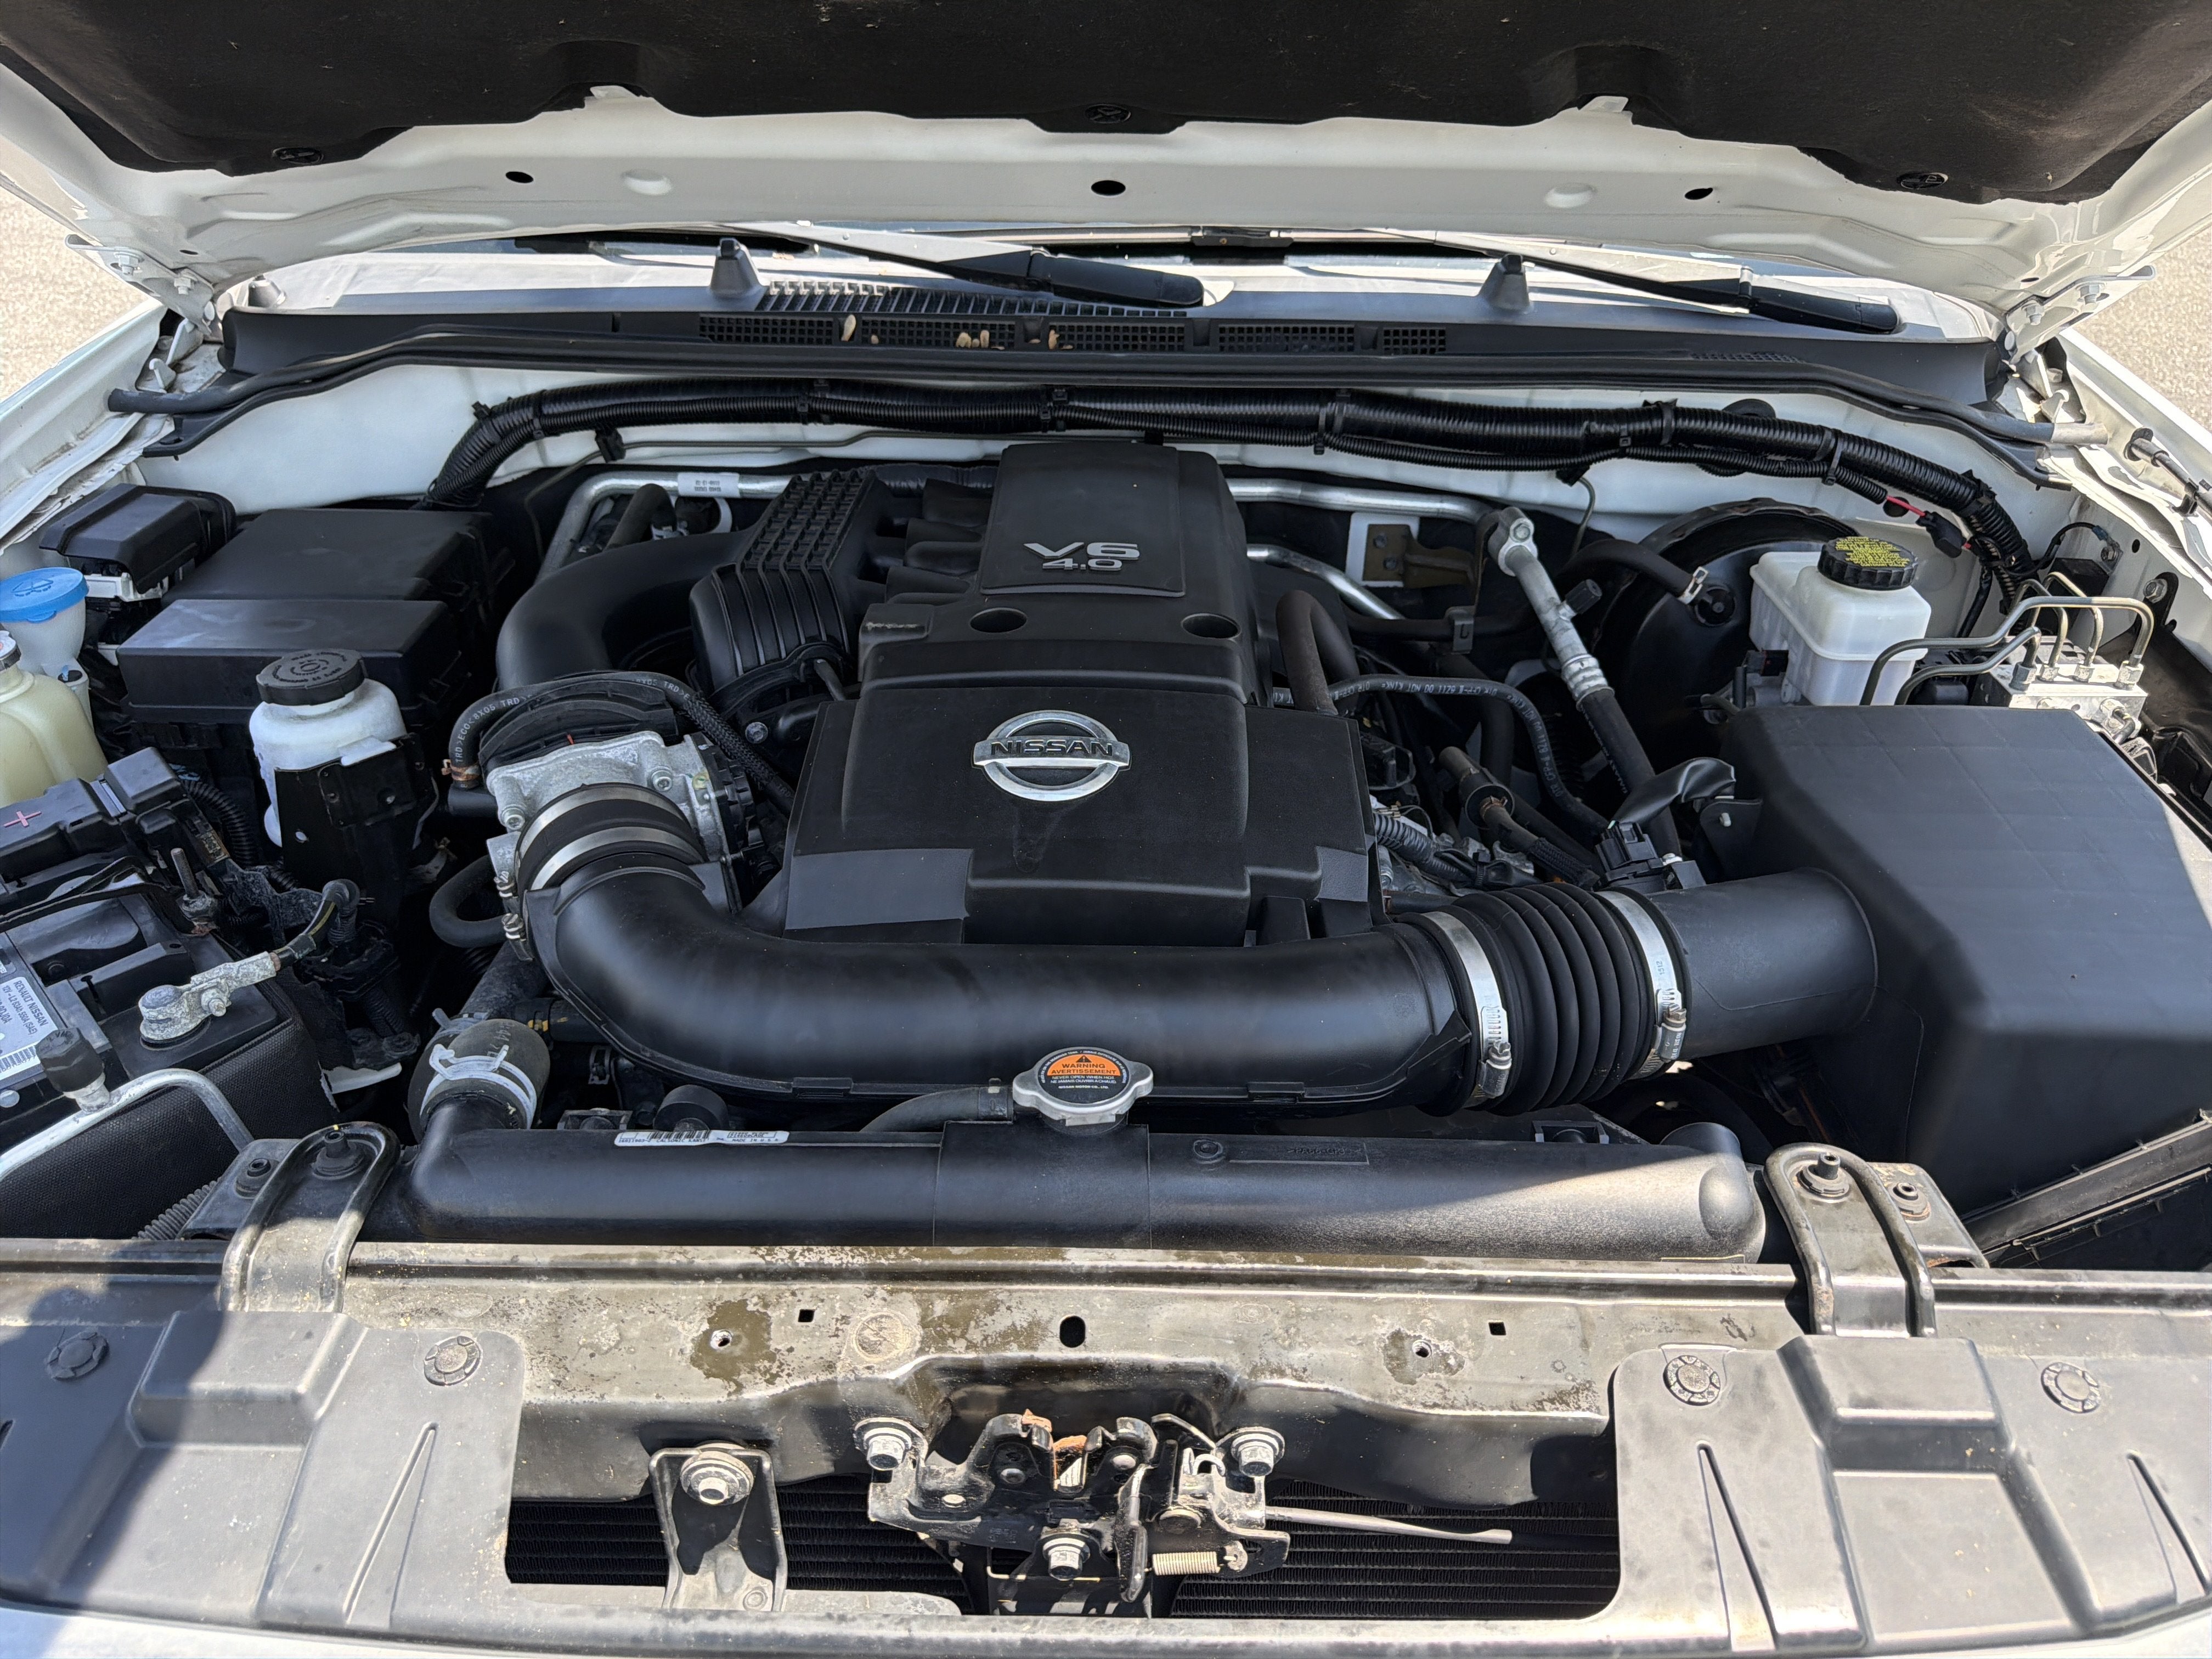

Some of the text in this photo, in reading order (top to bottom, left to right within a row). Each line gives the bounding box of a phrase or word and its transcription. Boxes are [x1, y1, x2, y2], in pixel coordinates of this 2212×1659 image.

[1023, 541, 1140, 560] V6
[1042, 558, 1122, 571] 4.0
[991, 739, 1113, 757] NISSAN
[2, 985, 12, 994] 12V
[22, 1021, 38, 1035] (SAE)
[13, 980, 49, 1026] RENAULT NISSAN
